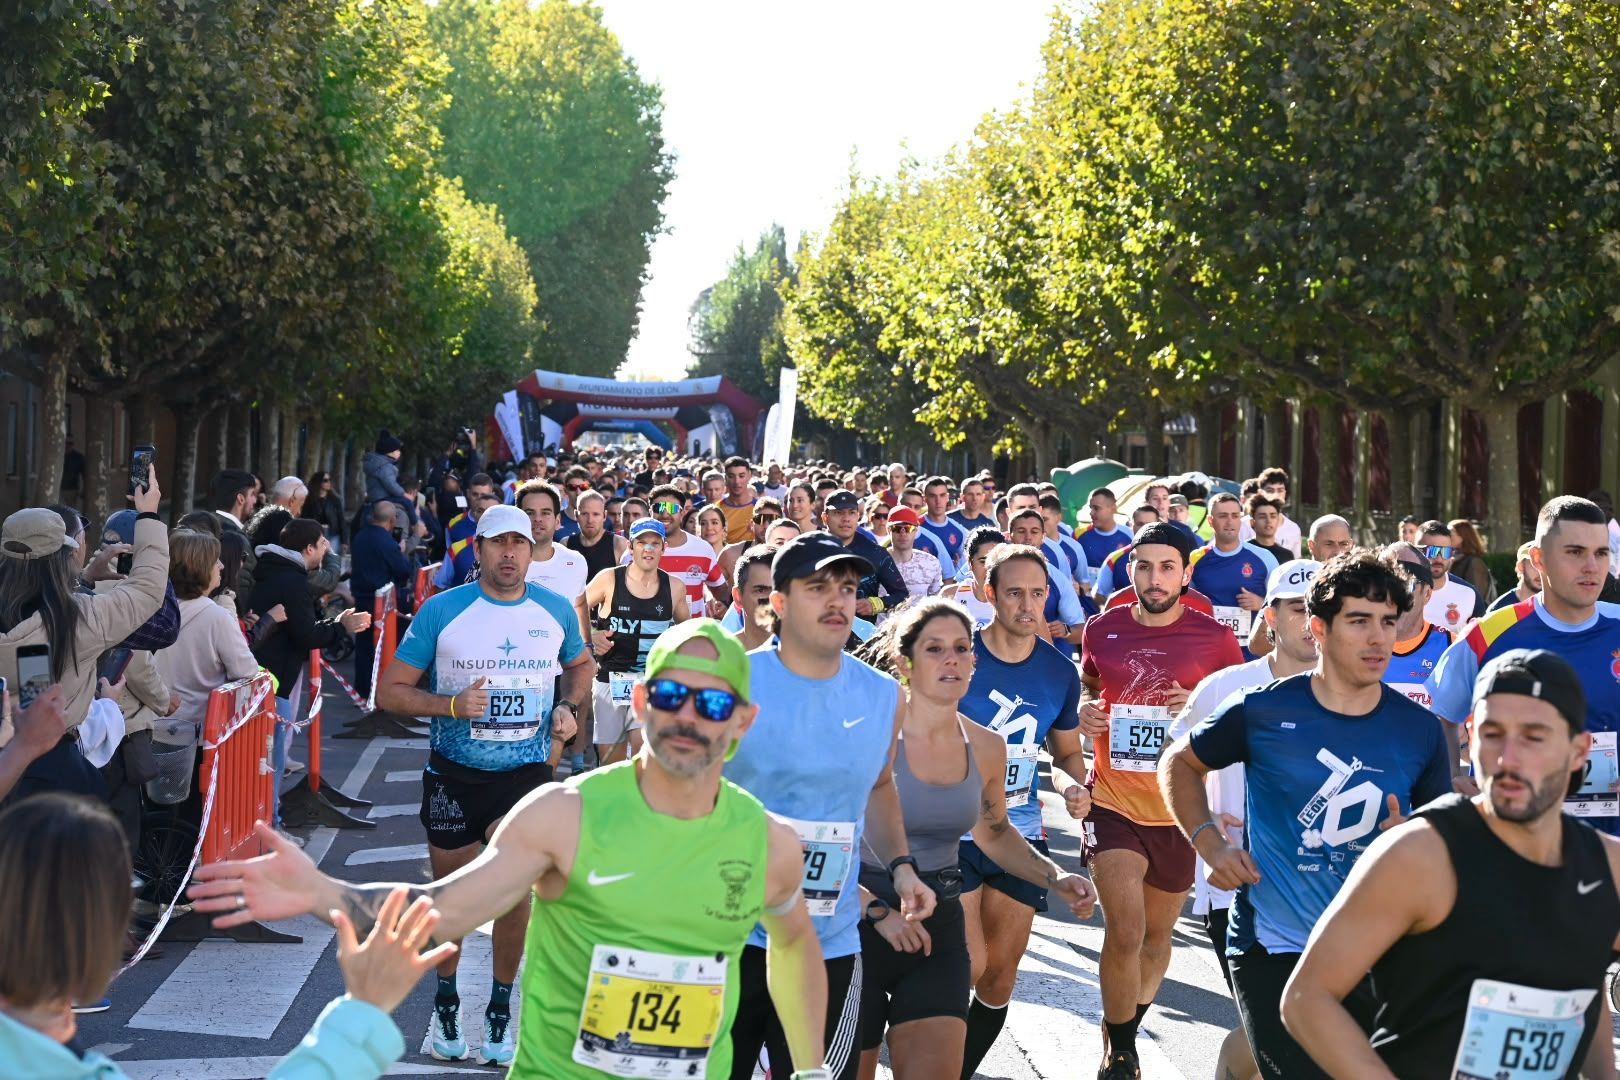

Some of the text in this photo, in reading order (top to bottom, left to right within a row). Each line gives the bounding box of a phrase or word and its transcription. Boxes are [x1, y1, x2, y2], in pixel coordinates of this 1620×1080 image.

[578, 383, 642, 396] AYUNTAMIENTO
[644, 386, 655, 396] DE
[609, 616, 639, 634] SLY
[490, 695, 525, 717] 623
[1129, 726, 1165, 748] 529
[627, 991, 681, 1034] 134
[1500, 1027, 1565, 1071] 638
